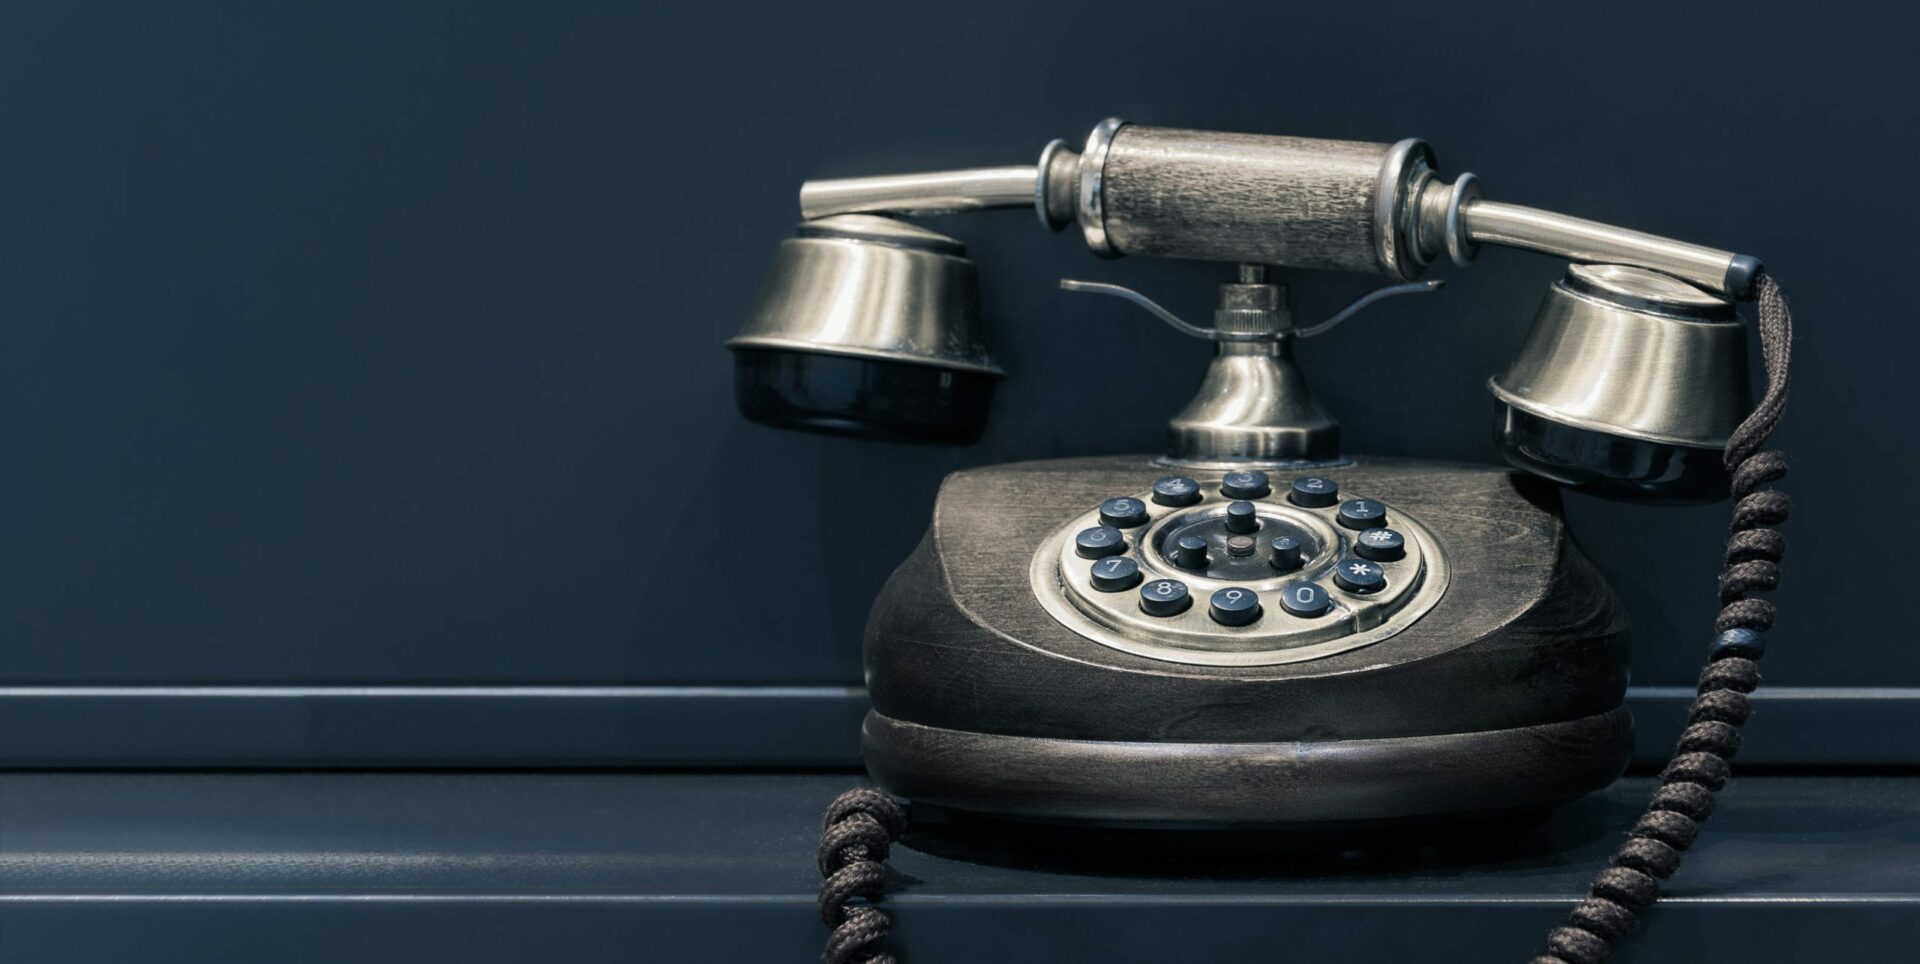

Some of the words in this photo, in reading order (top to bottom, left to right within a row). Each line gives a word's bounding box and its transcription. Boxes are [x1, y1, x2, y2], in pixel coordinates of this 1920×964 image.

[1167, 479, 1184, 488] 4
[1307, 478, 1323, 488] 2
[1114, 499, 1129, 511] 5
[1356, 501, 1368, 512] 1
[1091, 529, 1106, 541] 6
[1369, 531, 1392, 540] #
[1106, 560, 1121, 572] 7
[1157, 582, 1172, 595] 8
[1226, 590, 1242, 604] 9
[1296, 587, 1314, 603] 0
